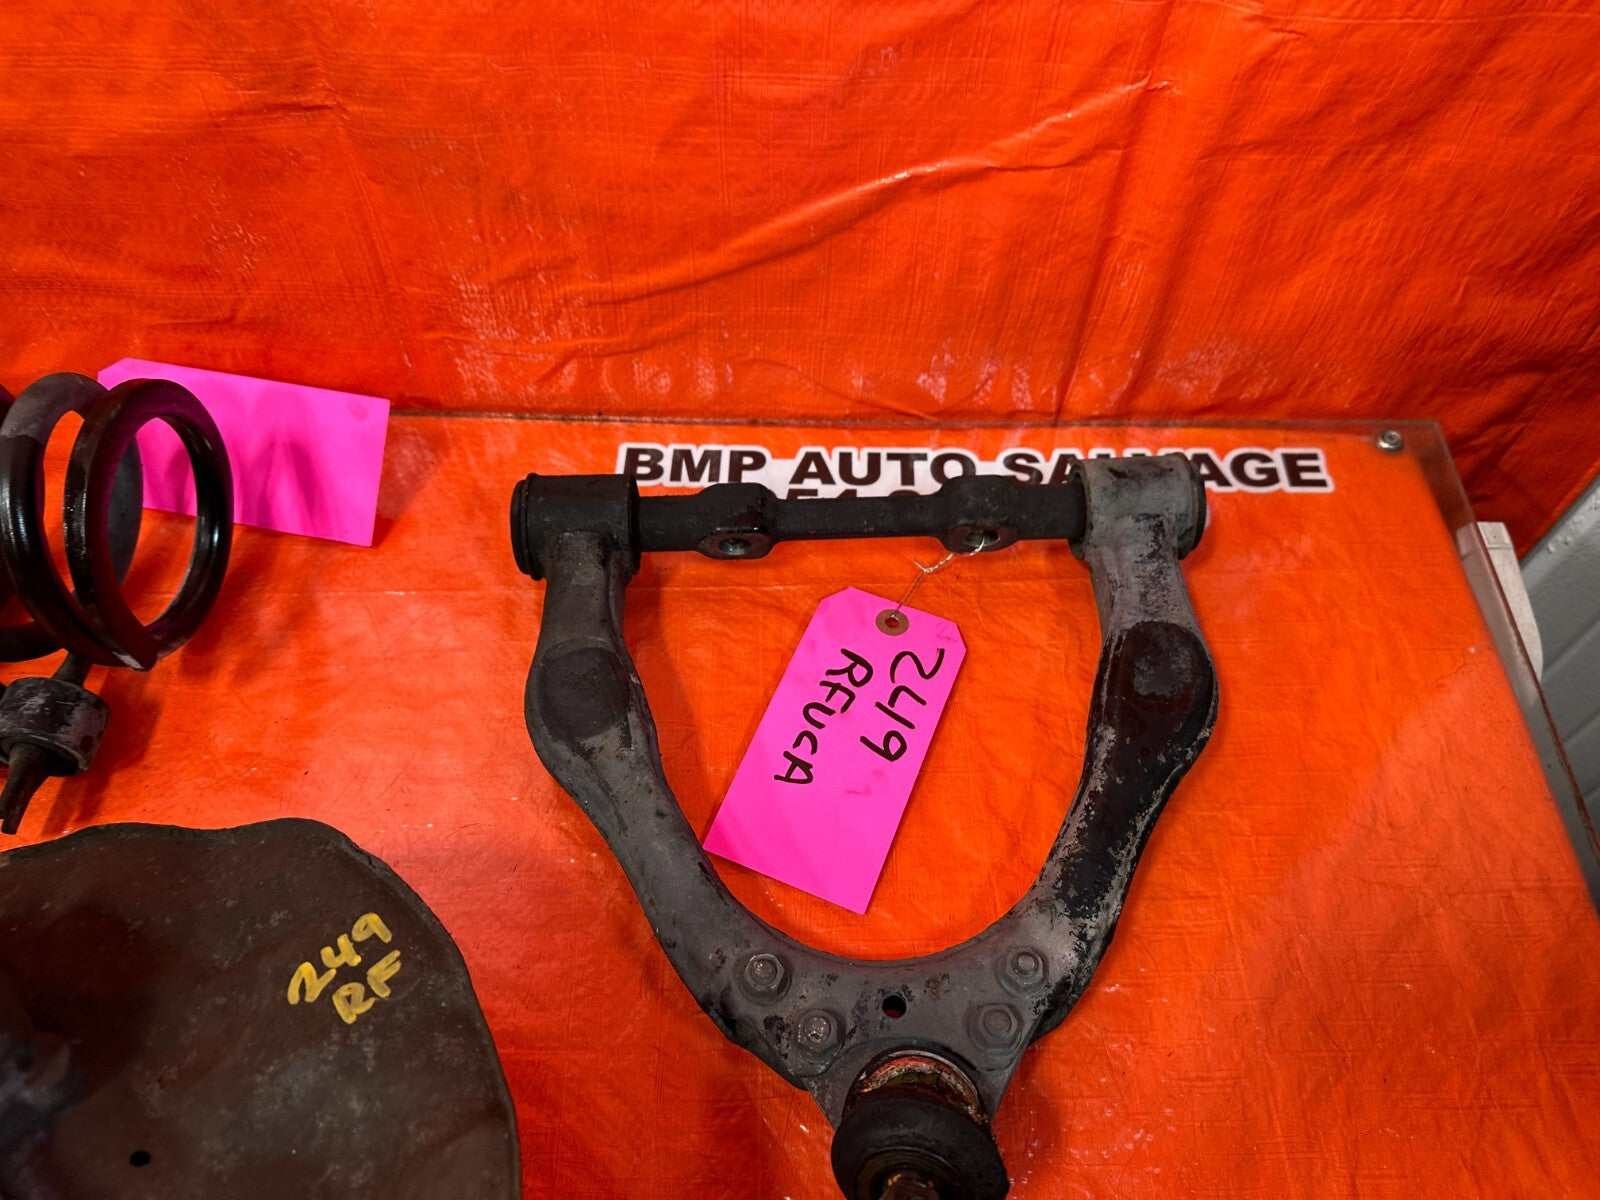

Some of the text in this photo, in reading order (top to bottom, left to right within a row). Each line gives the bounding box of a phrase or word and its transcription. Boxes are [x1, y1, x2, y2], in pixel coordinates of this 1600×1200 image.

[623, 447, 1328, 487] BMP AUTO SAAGE
[773, 648, 873, 784] RFUCA
[287, 912, 393, 1005] 249
[331, 949, 402, 1025] RF
